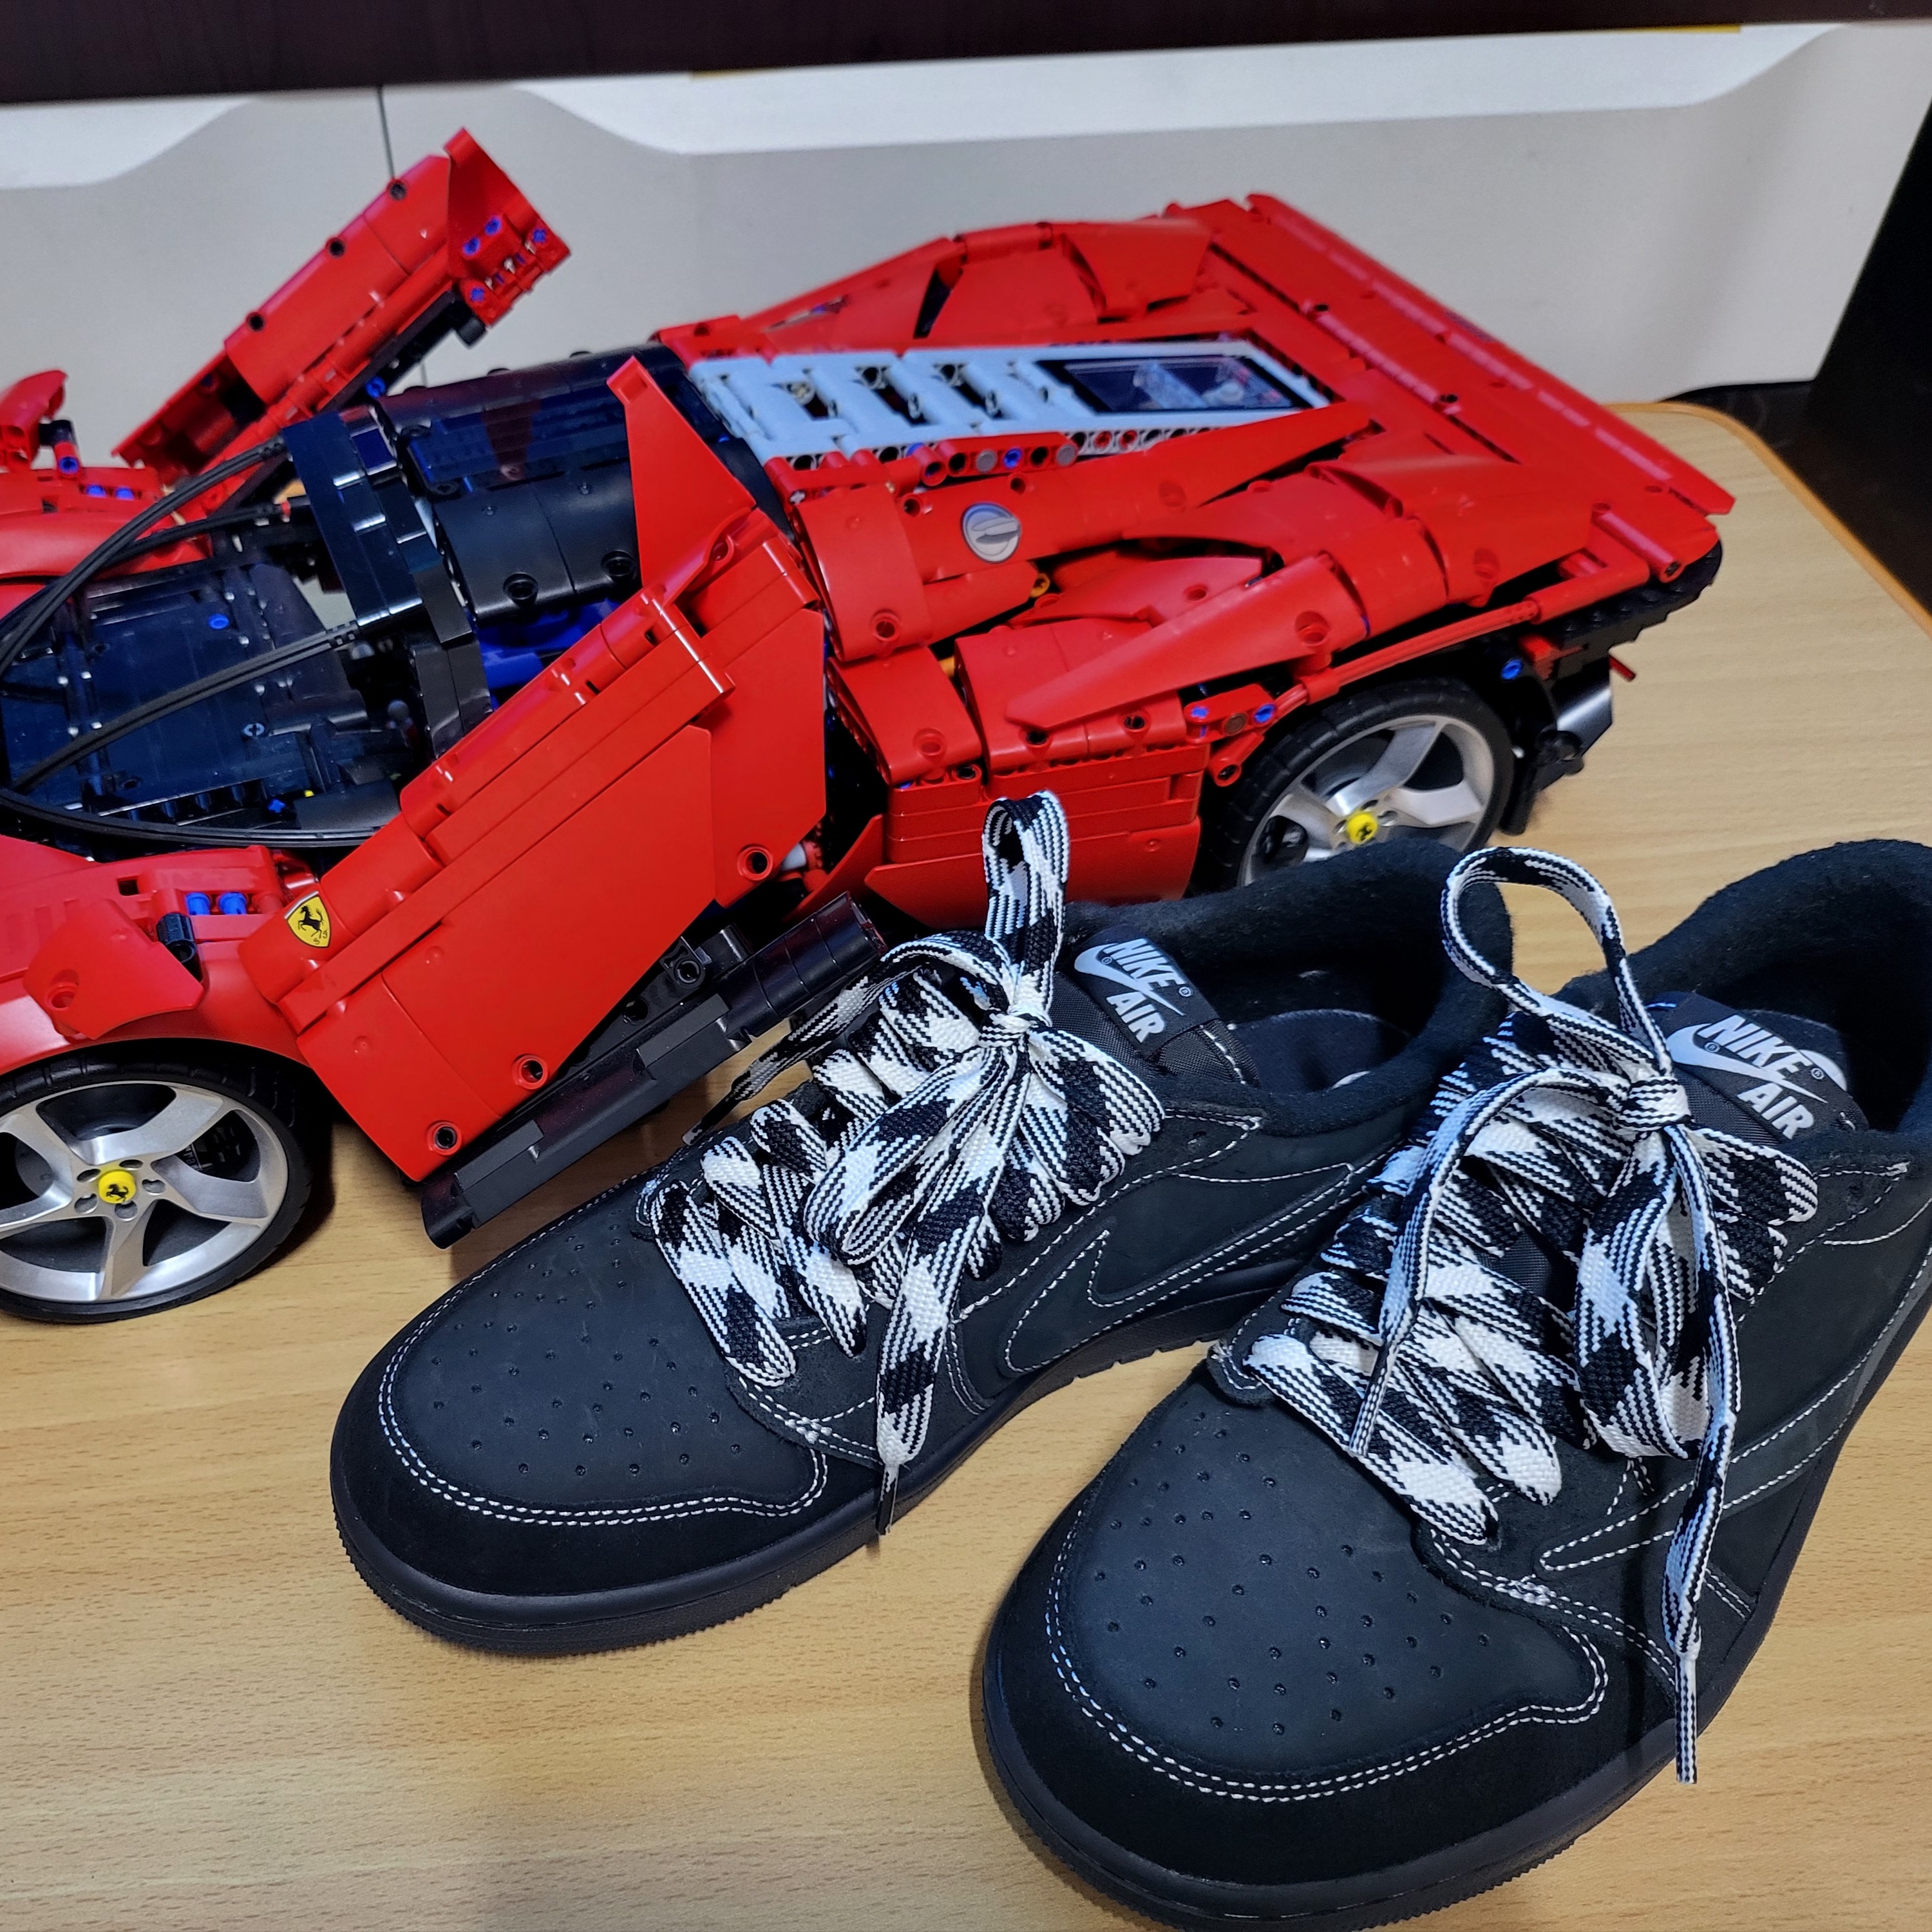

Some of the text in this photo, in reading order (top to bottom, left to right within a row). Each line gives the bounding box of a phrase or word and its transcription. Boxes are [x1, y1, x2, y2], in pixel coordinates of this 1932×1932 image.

[1103, 938, 1186, 990] NIKE
[1106, 991, 1165, 1043] AIR
[1697, 1014, 1814, 1080] NIKE
[1737, 1083, 1814, 1141] AIR
